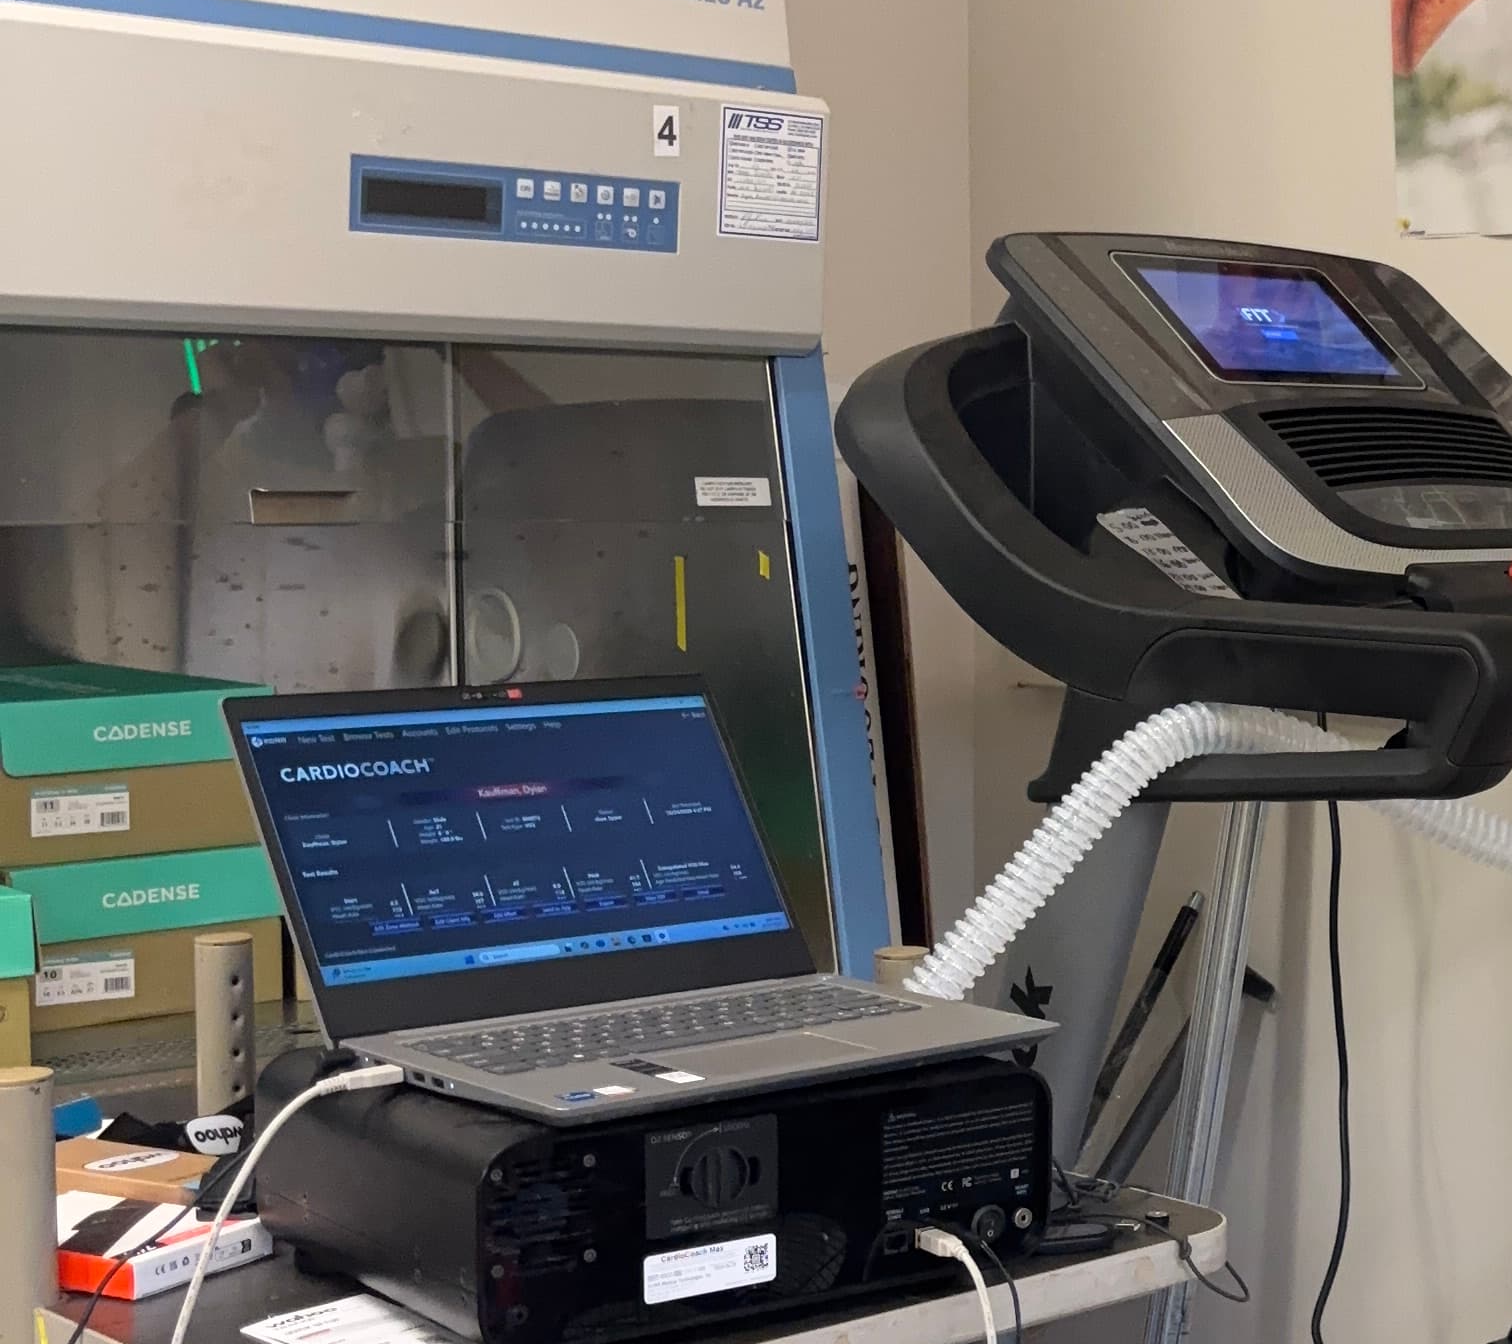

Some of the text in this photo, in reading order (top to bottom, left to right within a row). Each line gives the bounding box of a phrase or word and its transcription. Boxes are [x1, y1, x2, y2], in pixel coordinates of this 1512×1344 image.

[657, 114, 677, 146] 4
[744, 114, 784, 131] TSS
[93, 719, 192, 742] CADENSE
[101, 883, 201, 909] CADENSE
[44, 970, 57, 979] 10
[194, 1126, 243, 1146] wahoo
